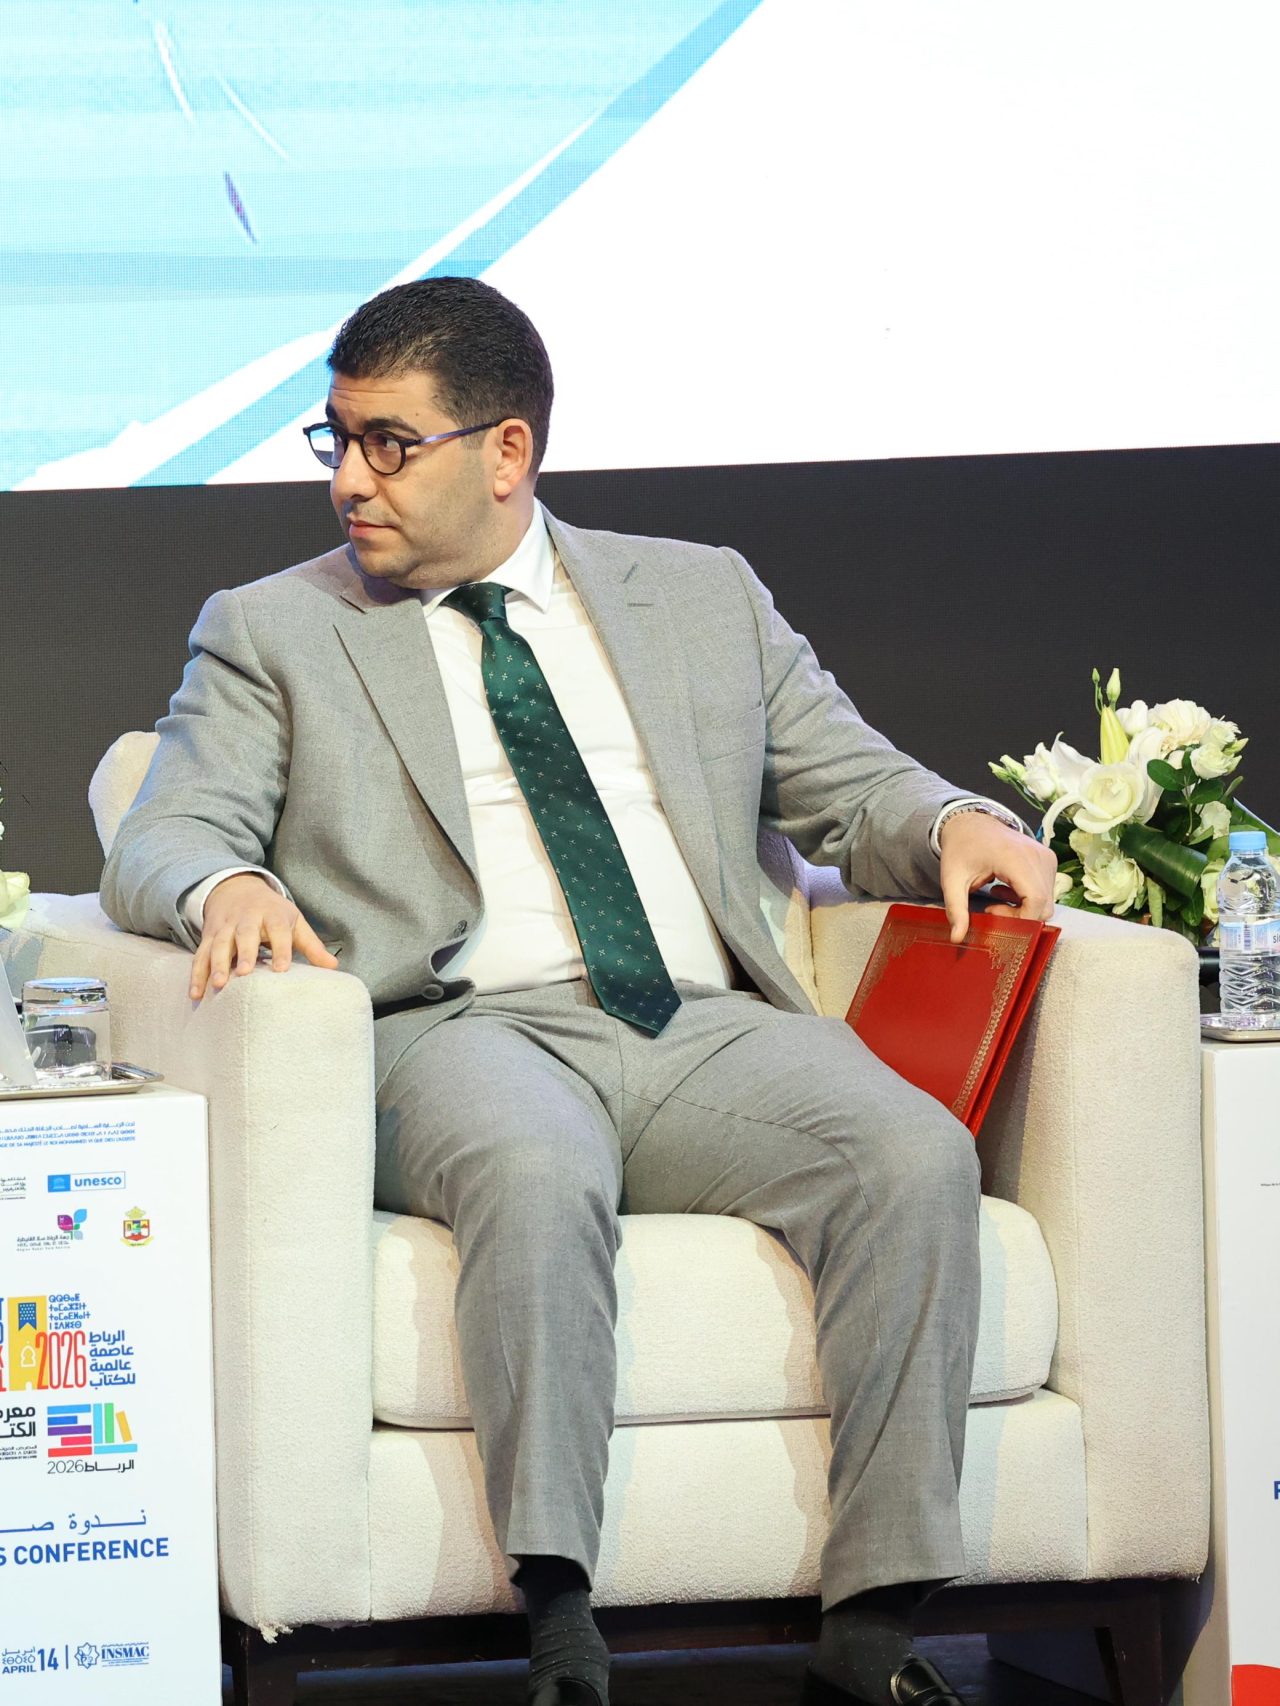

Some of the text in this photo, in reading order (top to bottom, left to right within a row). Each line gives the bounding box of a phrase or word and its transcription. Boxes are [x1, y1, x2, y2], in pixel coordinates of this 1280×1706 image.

[74, 1176, 122, 1187] unesco
[89, 1330, 125, 1346] الرباط
[89, 1344, 134, 1357] عاصمة
[35, 1330, 87, 1391] 2026
[90, 1358, 132, 1376] عالمية
[90, 1373, 136, 1391] للكتاب
[68, 1509, 147, 1535] ندوة
[14, 1537, 169, 1566] CONFERENCE
[37, 1648, 59, 1672] 14
[101, 1646, 150, 1660] INSMAC
[1, 1664, 37, 1675] APRIL
